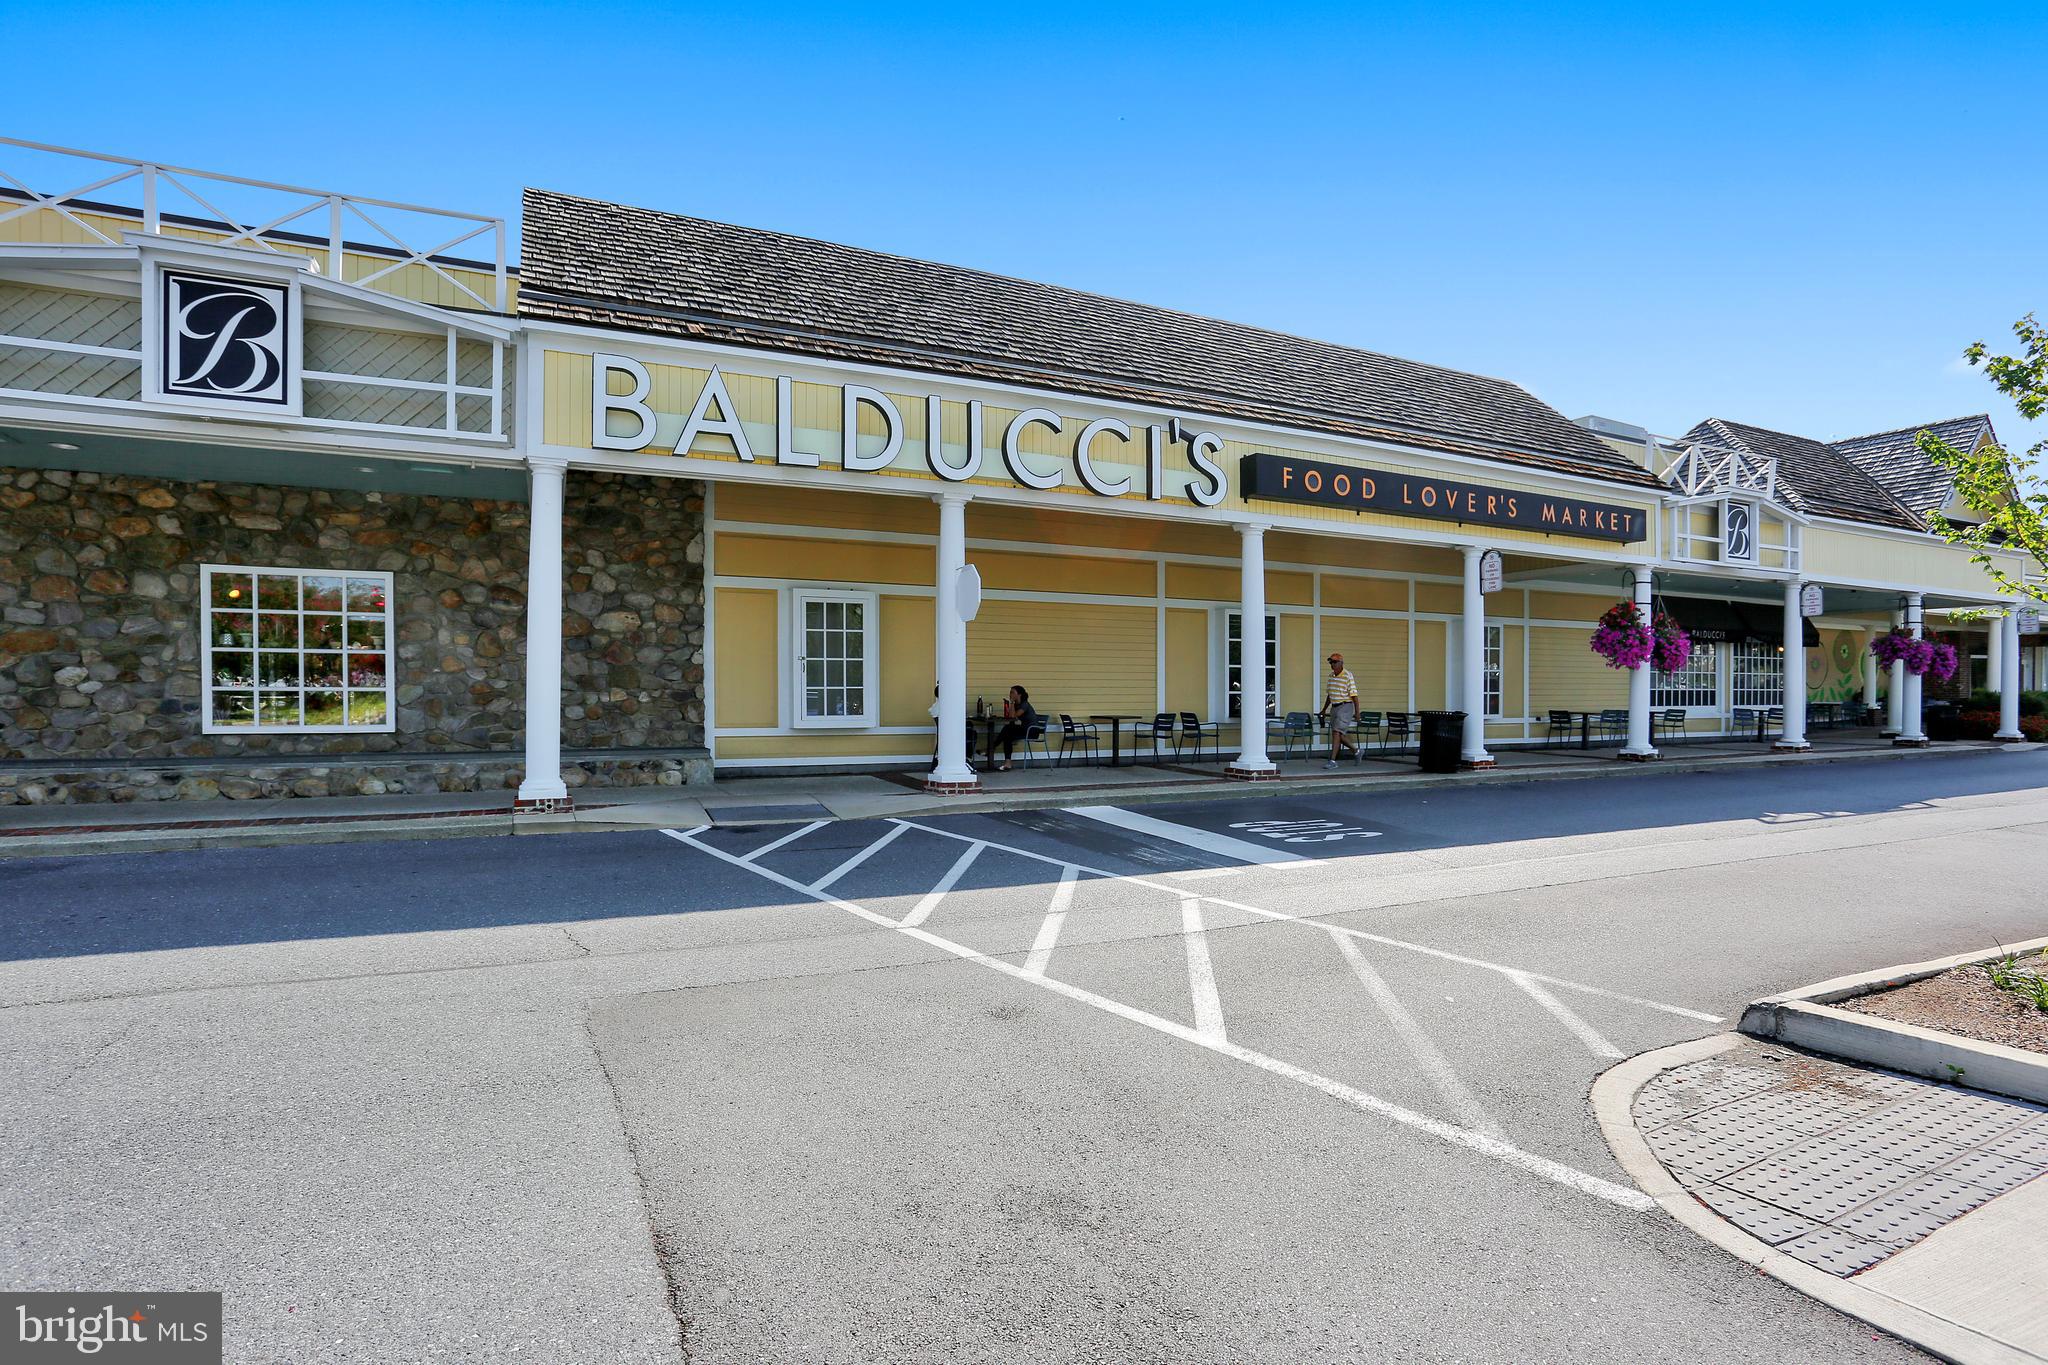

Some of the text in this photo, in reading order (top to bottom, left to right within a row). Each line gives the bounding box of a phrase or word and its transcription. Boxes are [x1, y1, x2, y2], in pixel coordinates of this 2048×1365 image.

[592, 352, 1228, 507] BALDUCCI'S
[1283, 467, 1632, 532] FOOD LOVER'S MARKET
[1229, 819, 1383, 842] STOP
